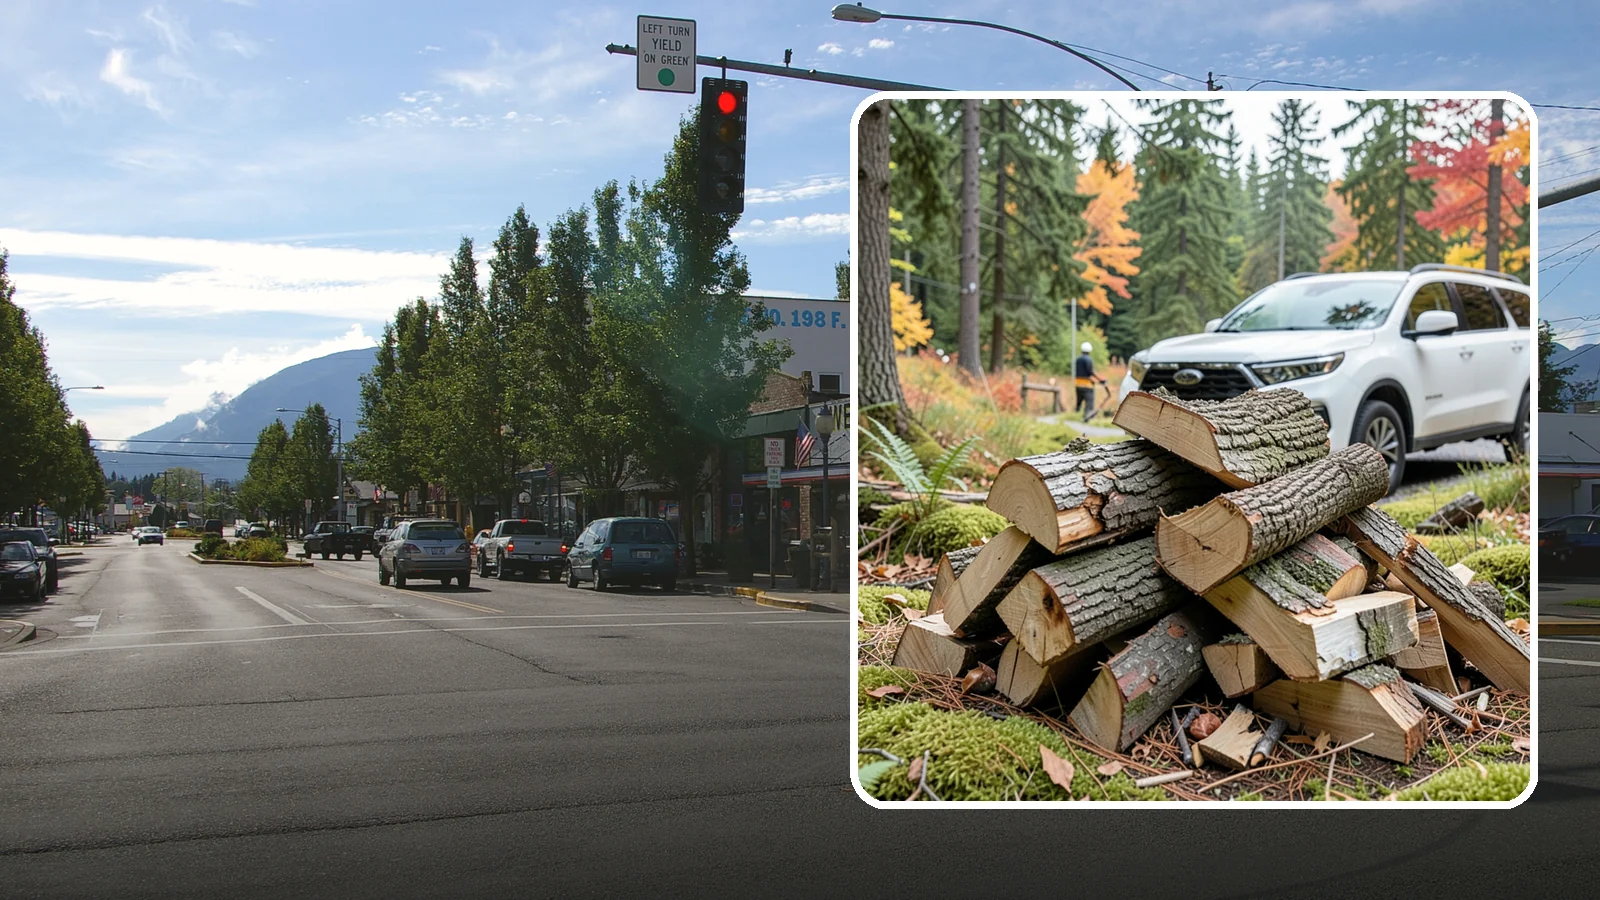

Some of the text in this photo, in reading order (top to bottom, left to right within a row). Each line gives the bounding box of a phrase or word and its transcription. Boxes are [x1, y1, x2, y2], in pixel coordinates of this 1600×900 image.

[643, 23, 689, 36] LEFT TURN
[652, 38, 681, 51] YIELD
[644, 53, 688, 66] ON GREEN
[757, 307, 786, 327] O.
[791, 309, 826, 328] 198
[831, 311, 846, 328] F.
